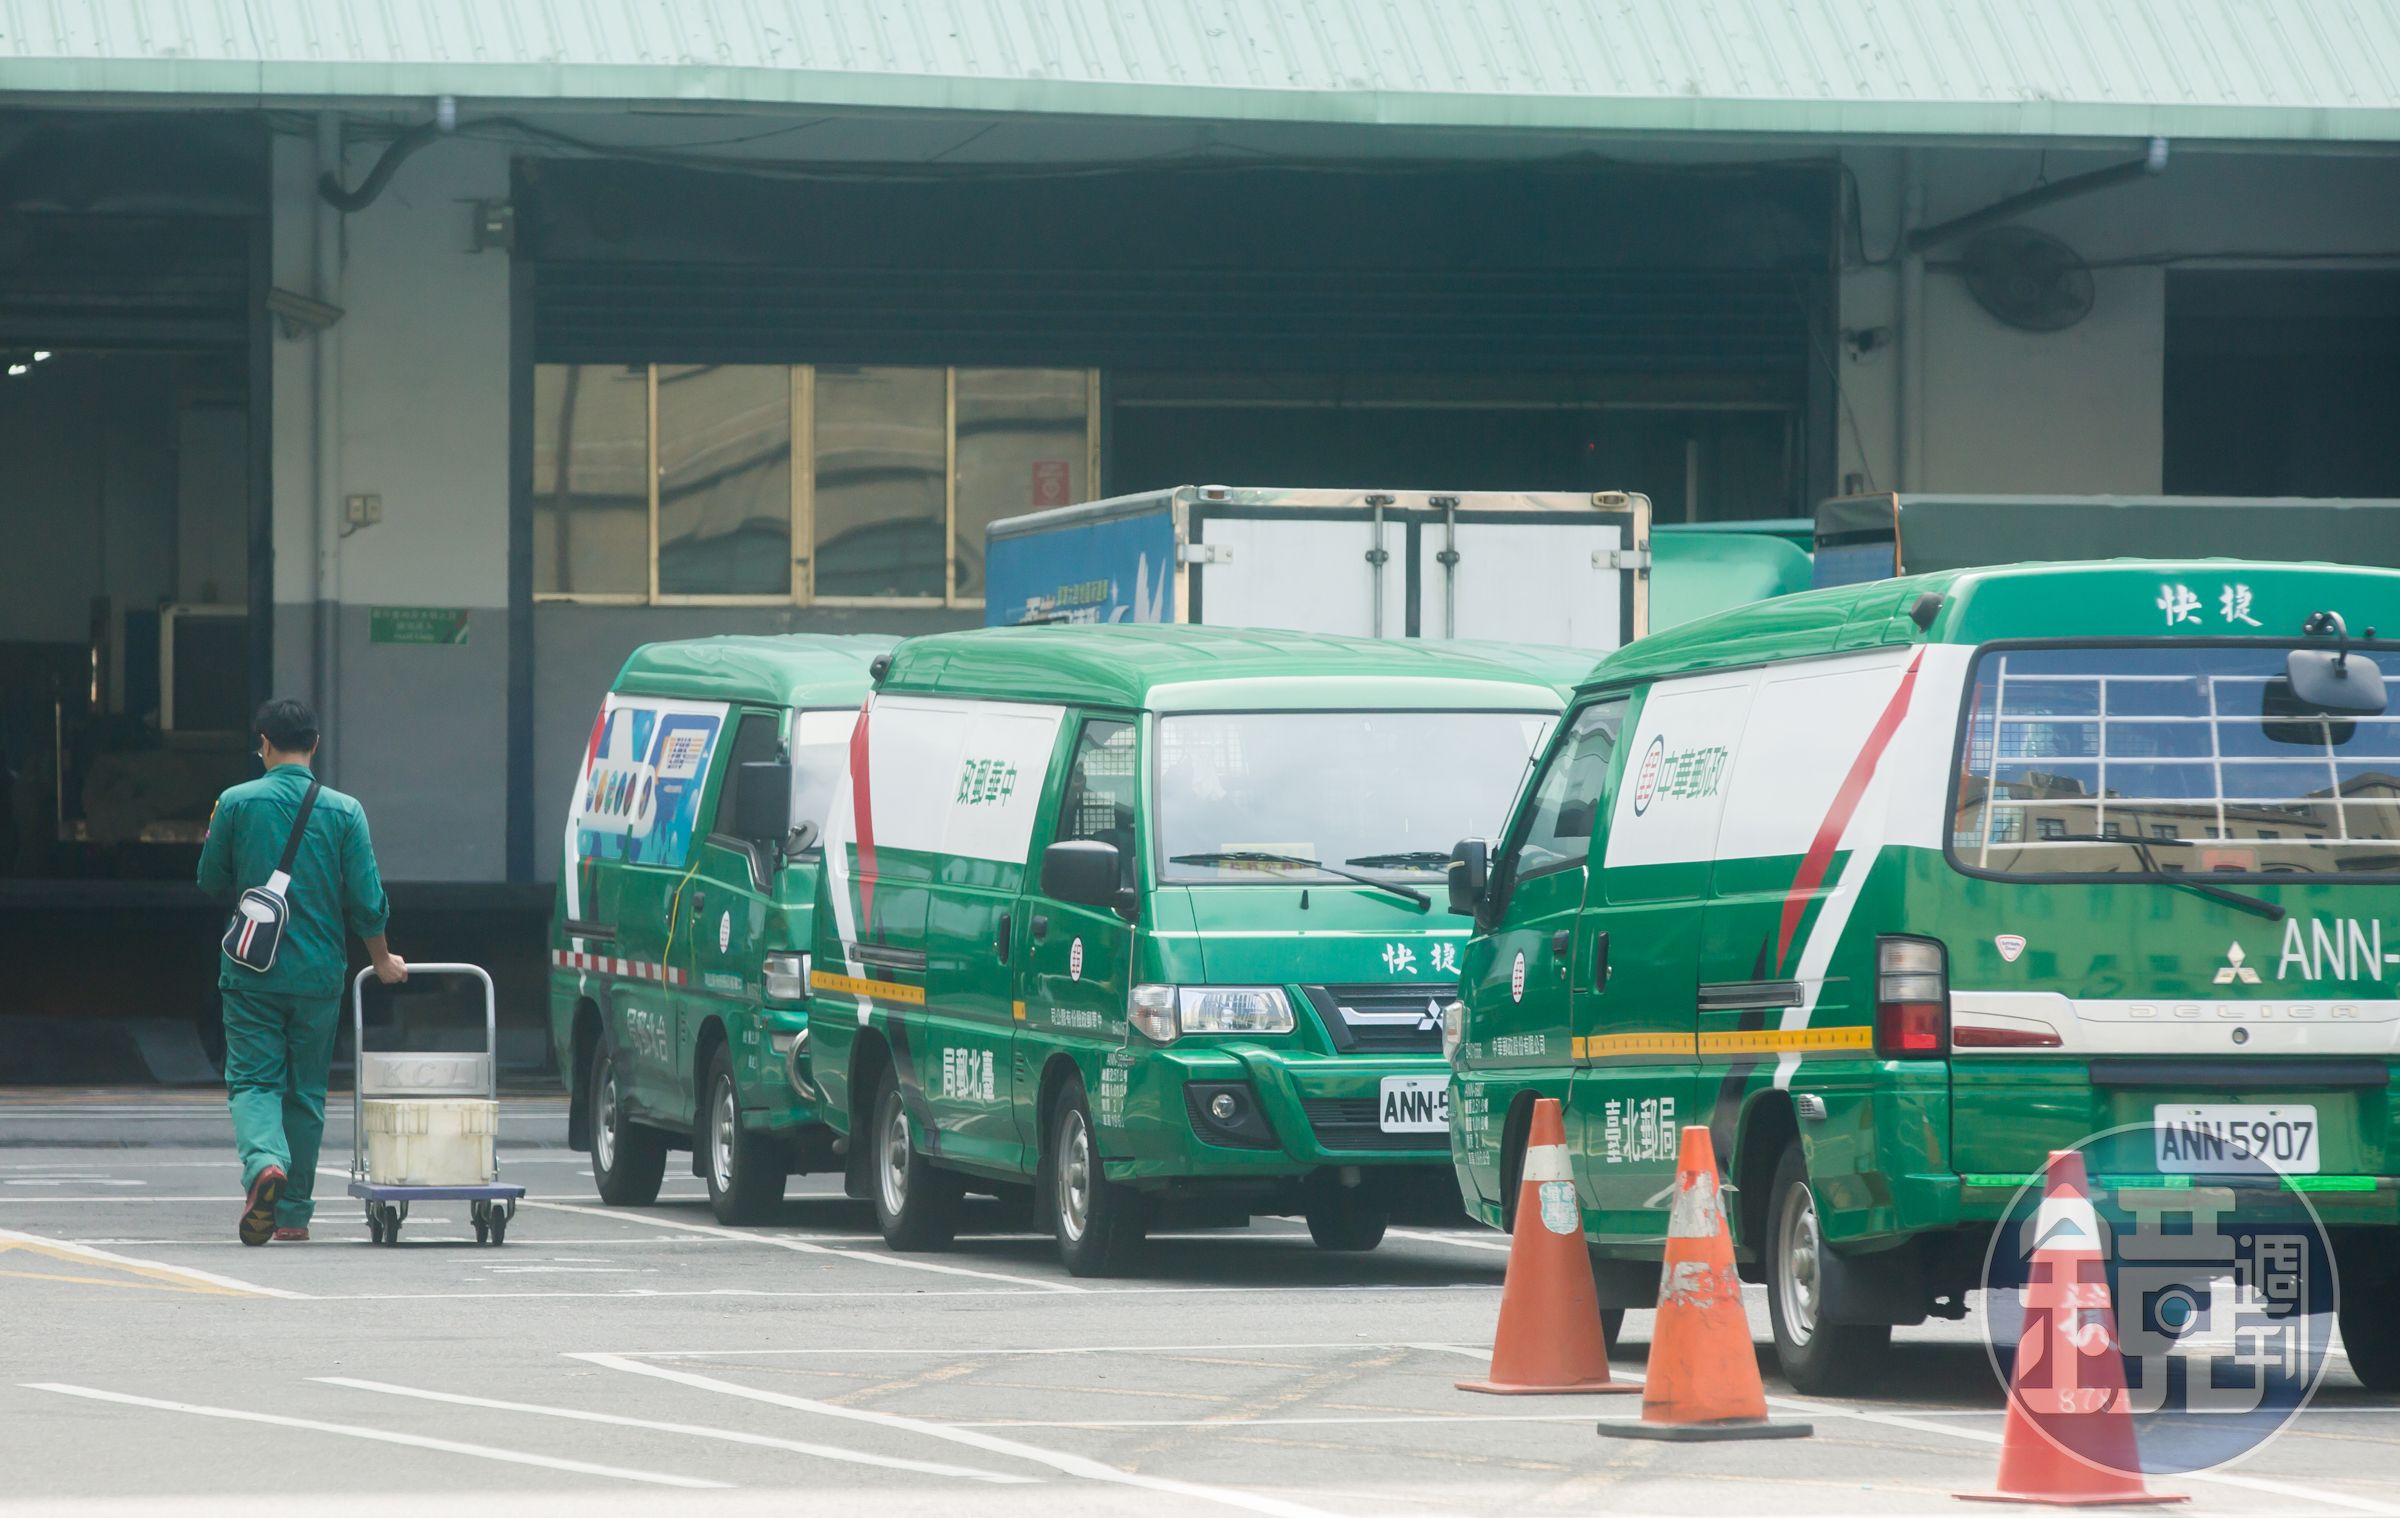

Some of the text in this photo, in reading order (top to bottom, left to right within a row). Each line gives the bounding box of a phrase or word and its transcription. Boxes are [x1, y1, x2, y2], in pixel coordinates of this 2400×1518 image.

[2156, 584, 2263, 626] 快捷
[1657, 746, 1727, 801] 中華郵政
[1382, 943, 1461, 975] 快捷
[2130, 1005, 2357, 1018] DELICA
[1605, 1097, 1676, 1163] 臺北郵局
[2162, 1121, 2313, 1160] ANN-5907
